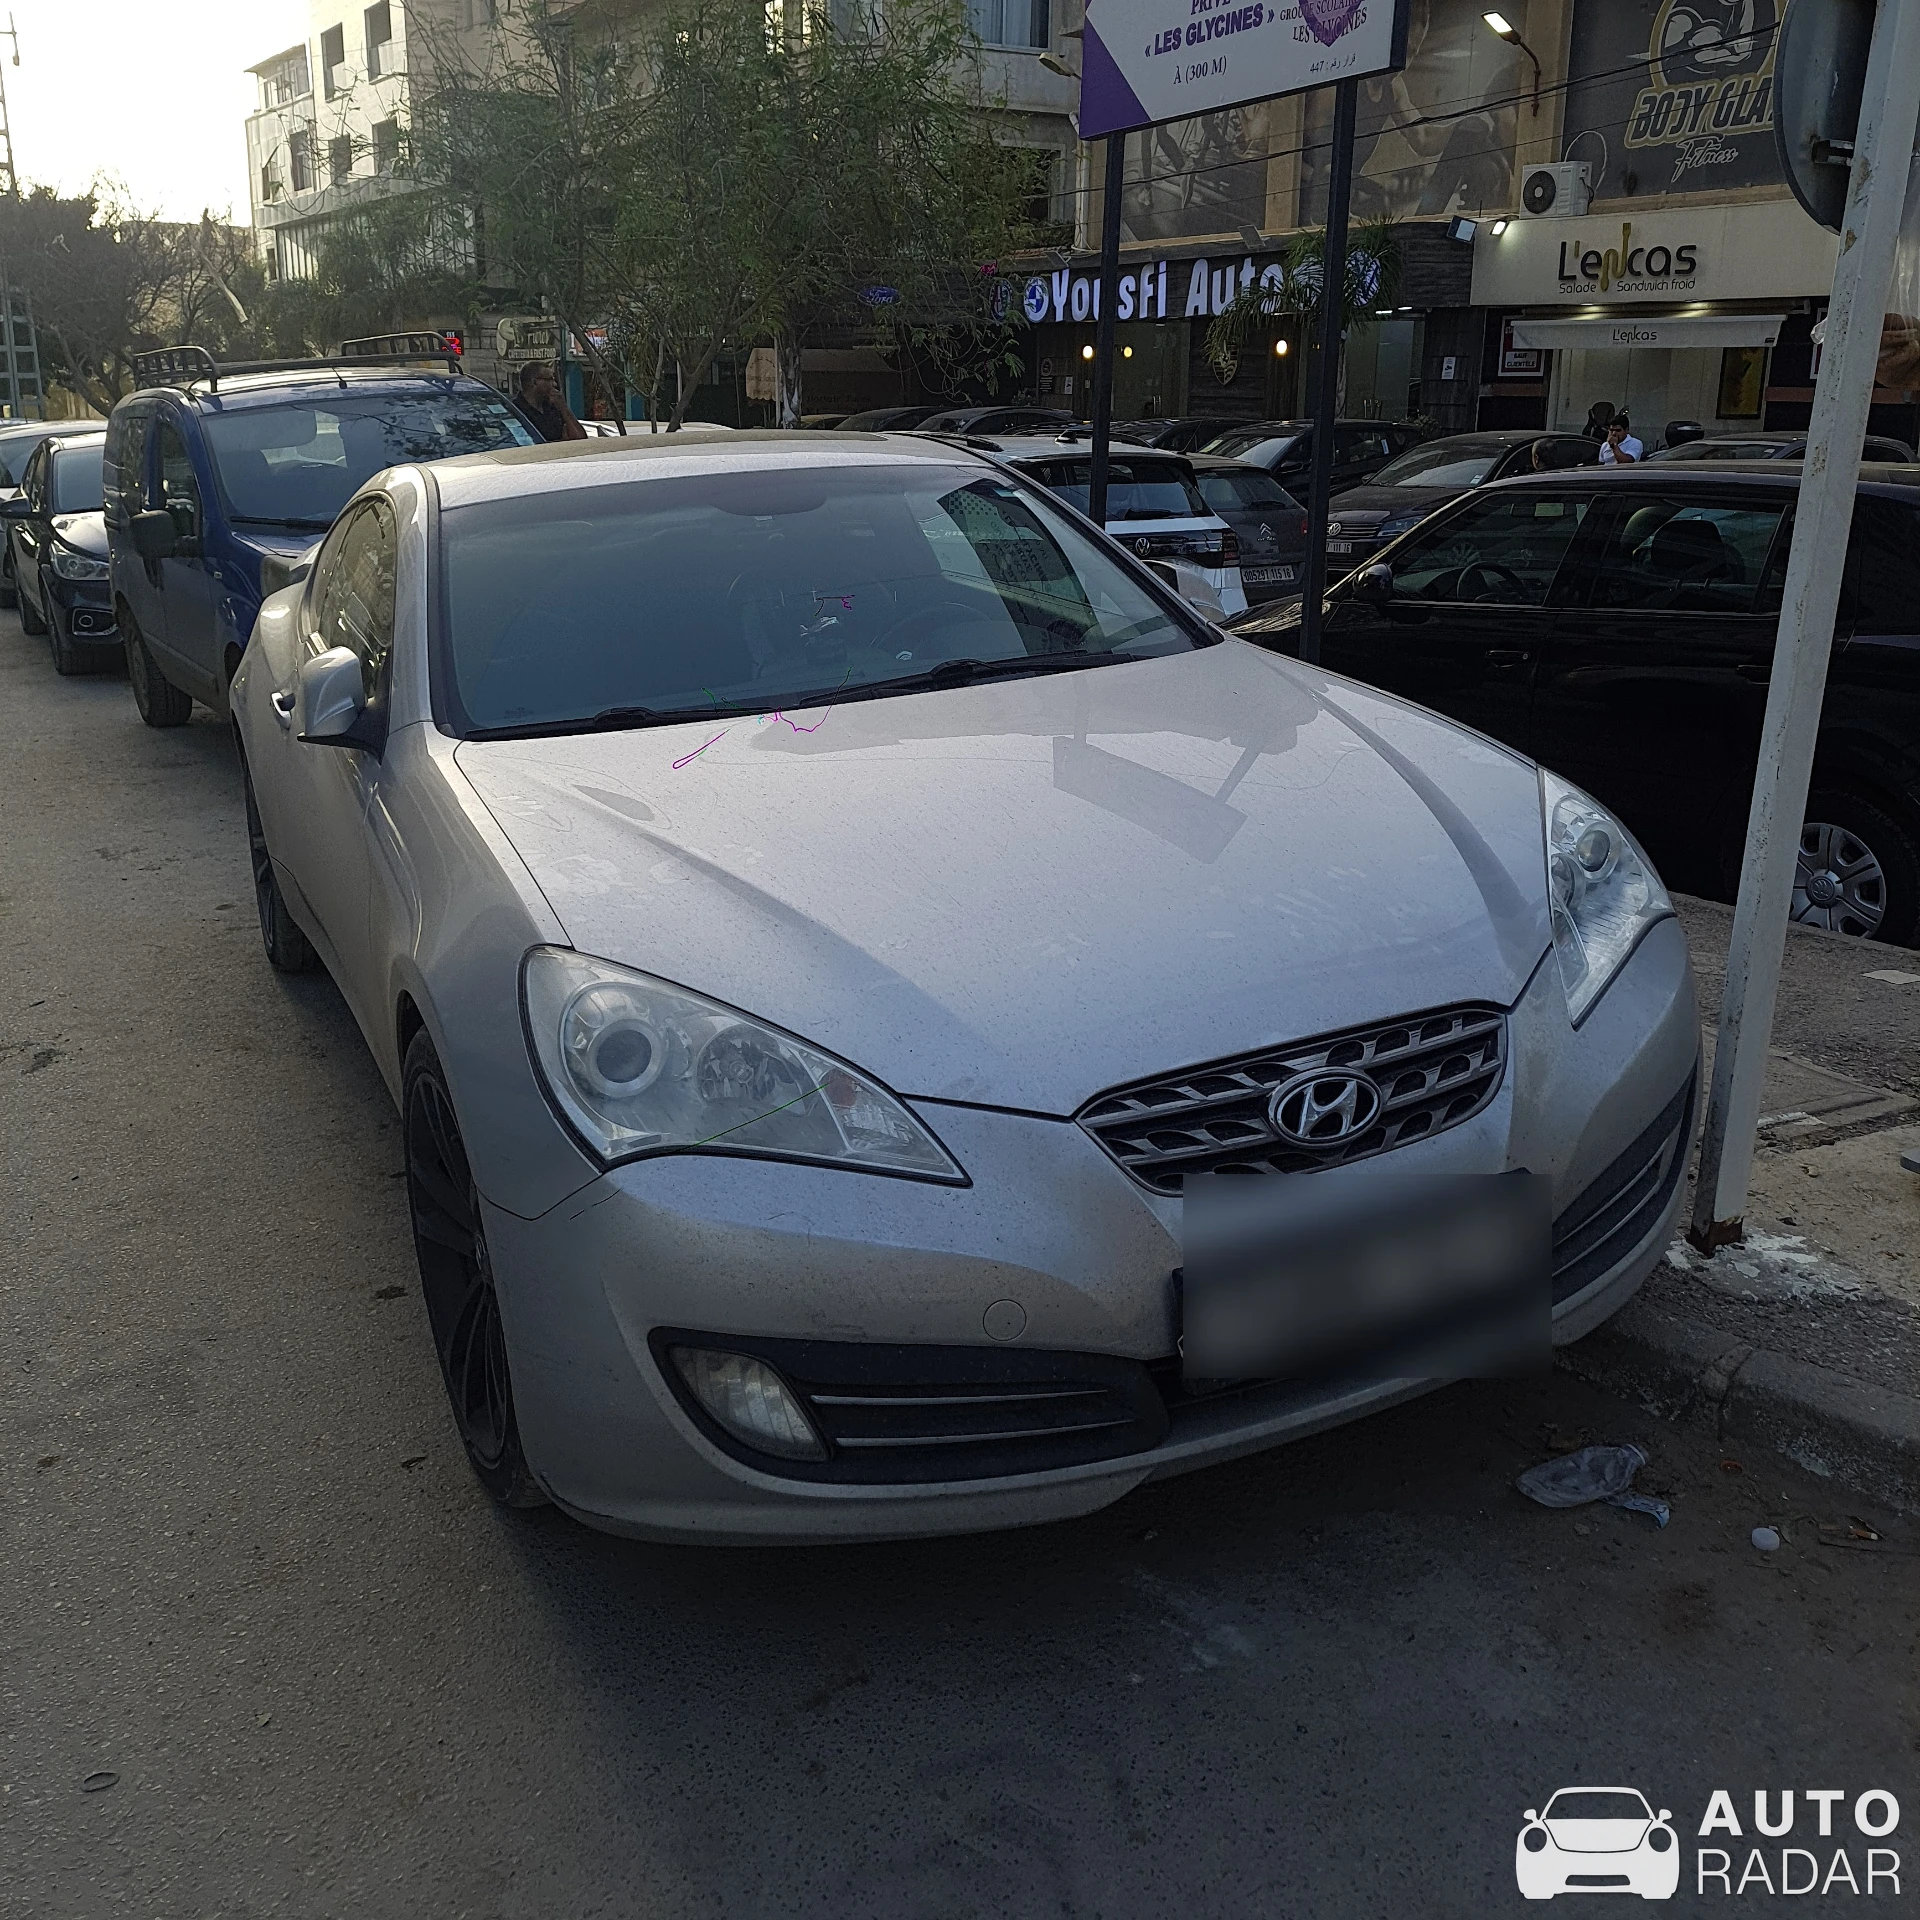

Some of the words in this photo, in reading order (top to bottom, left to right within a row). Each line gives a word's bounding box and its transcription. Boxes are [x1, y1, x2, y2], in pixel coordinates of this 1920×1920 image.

[1154, 30, 1182, 55] LES
[1185, 3, 1264, 46] GLYCINES
[1293, 26, 1310, 43] LES
[1313, 6, 1367, 43] GLYCINES
[1185, 61, 1209, 84] (300
[1211, 55, 1228, 76] M)
[1310, 60, 1324, 73] 447
[1670, 132, 1739, 183] Fitness
[1185, 257, 1284, 317] Auto
[1559, 282, 1597, 294] Salade
[1617, 279, 1669, 292] Sandwich
[1671, 277, 1696, 290] froid
